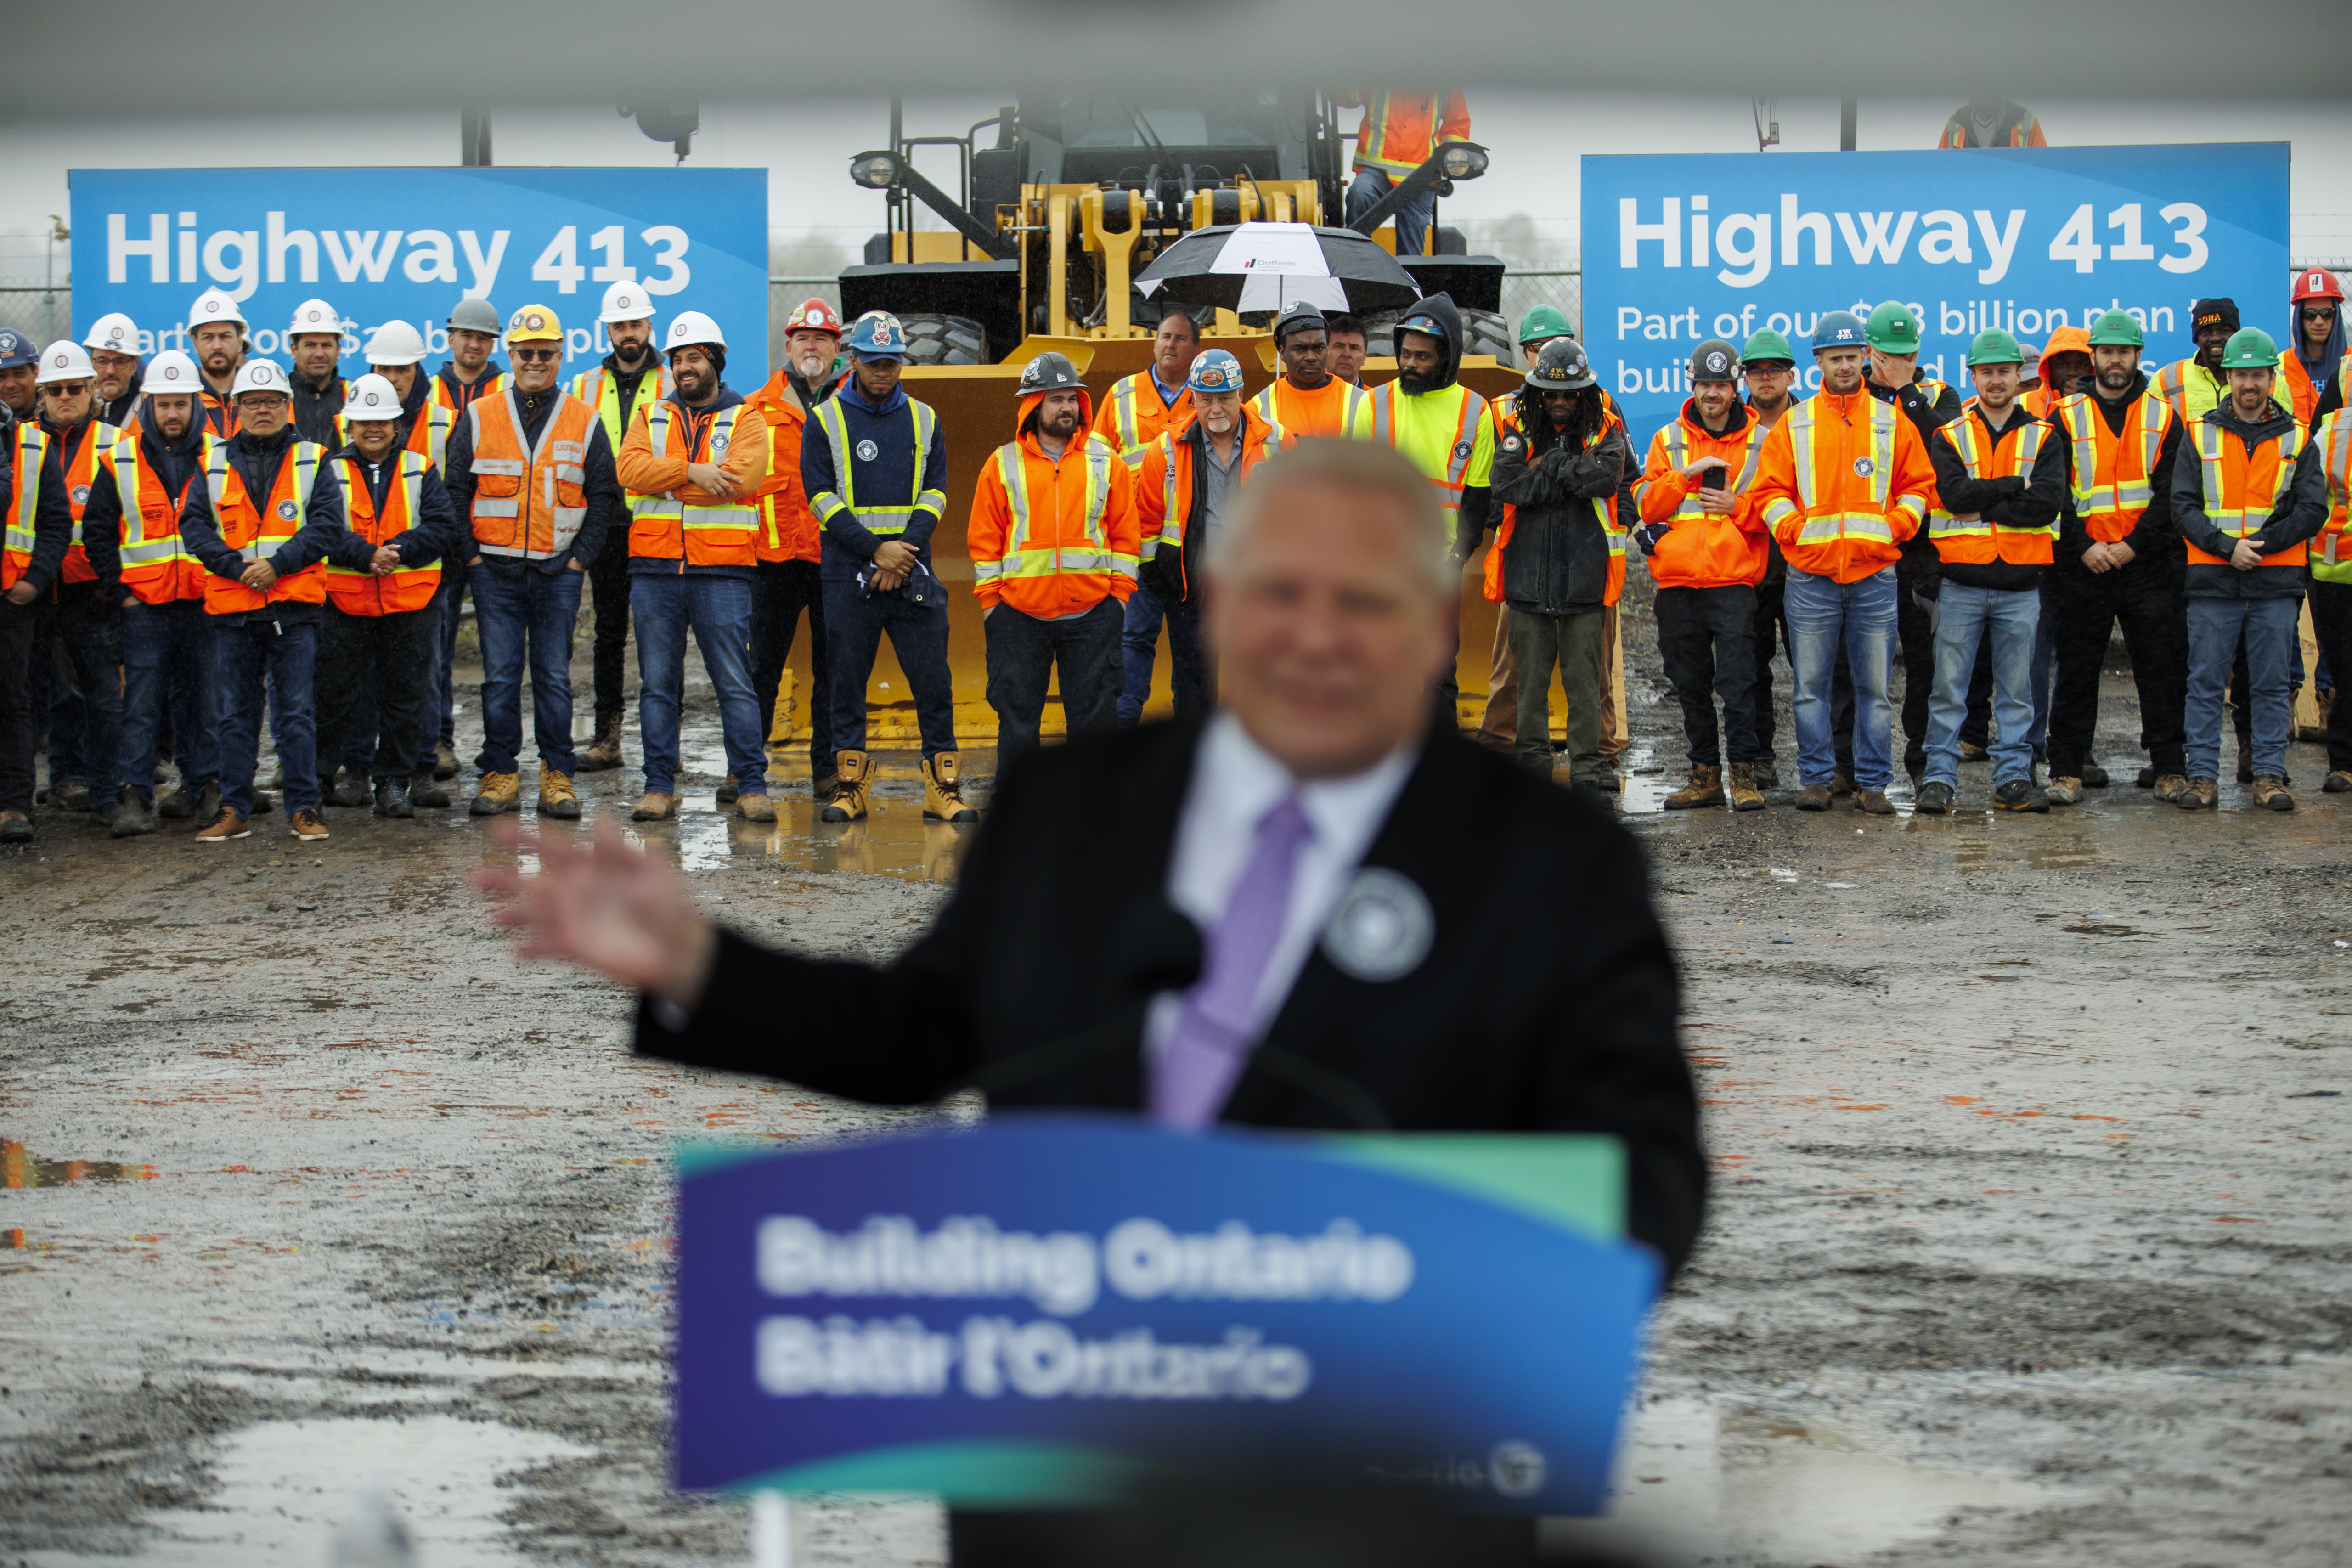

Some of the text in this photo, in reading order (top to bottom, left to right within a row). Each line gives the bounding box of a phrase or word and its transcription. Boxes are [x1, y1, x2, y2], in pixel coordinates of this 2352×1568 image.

[107, 211, 691, 304] Highway 413
[1619, 193, 2209, 288] Highway 413
[138, 322, 190, 355] art
[1618, 306, 1702, 340] Part
[1713, 304, 1757, 339] of
[1767, 311, 1829, 338] ou
[1940, 300, 2068, 335] billion
[753, 1213, 1417, 1318] Building Ontario
[753, 1314, 952, 1399] Bâtir
